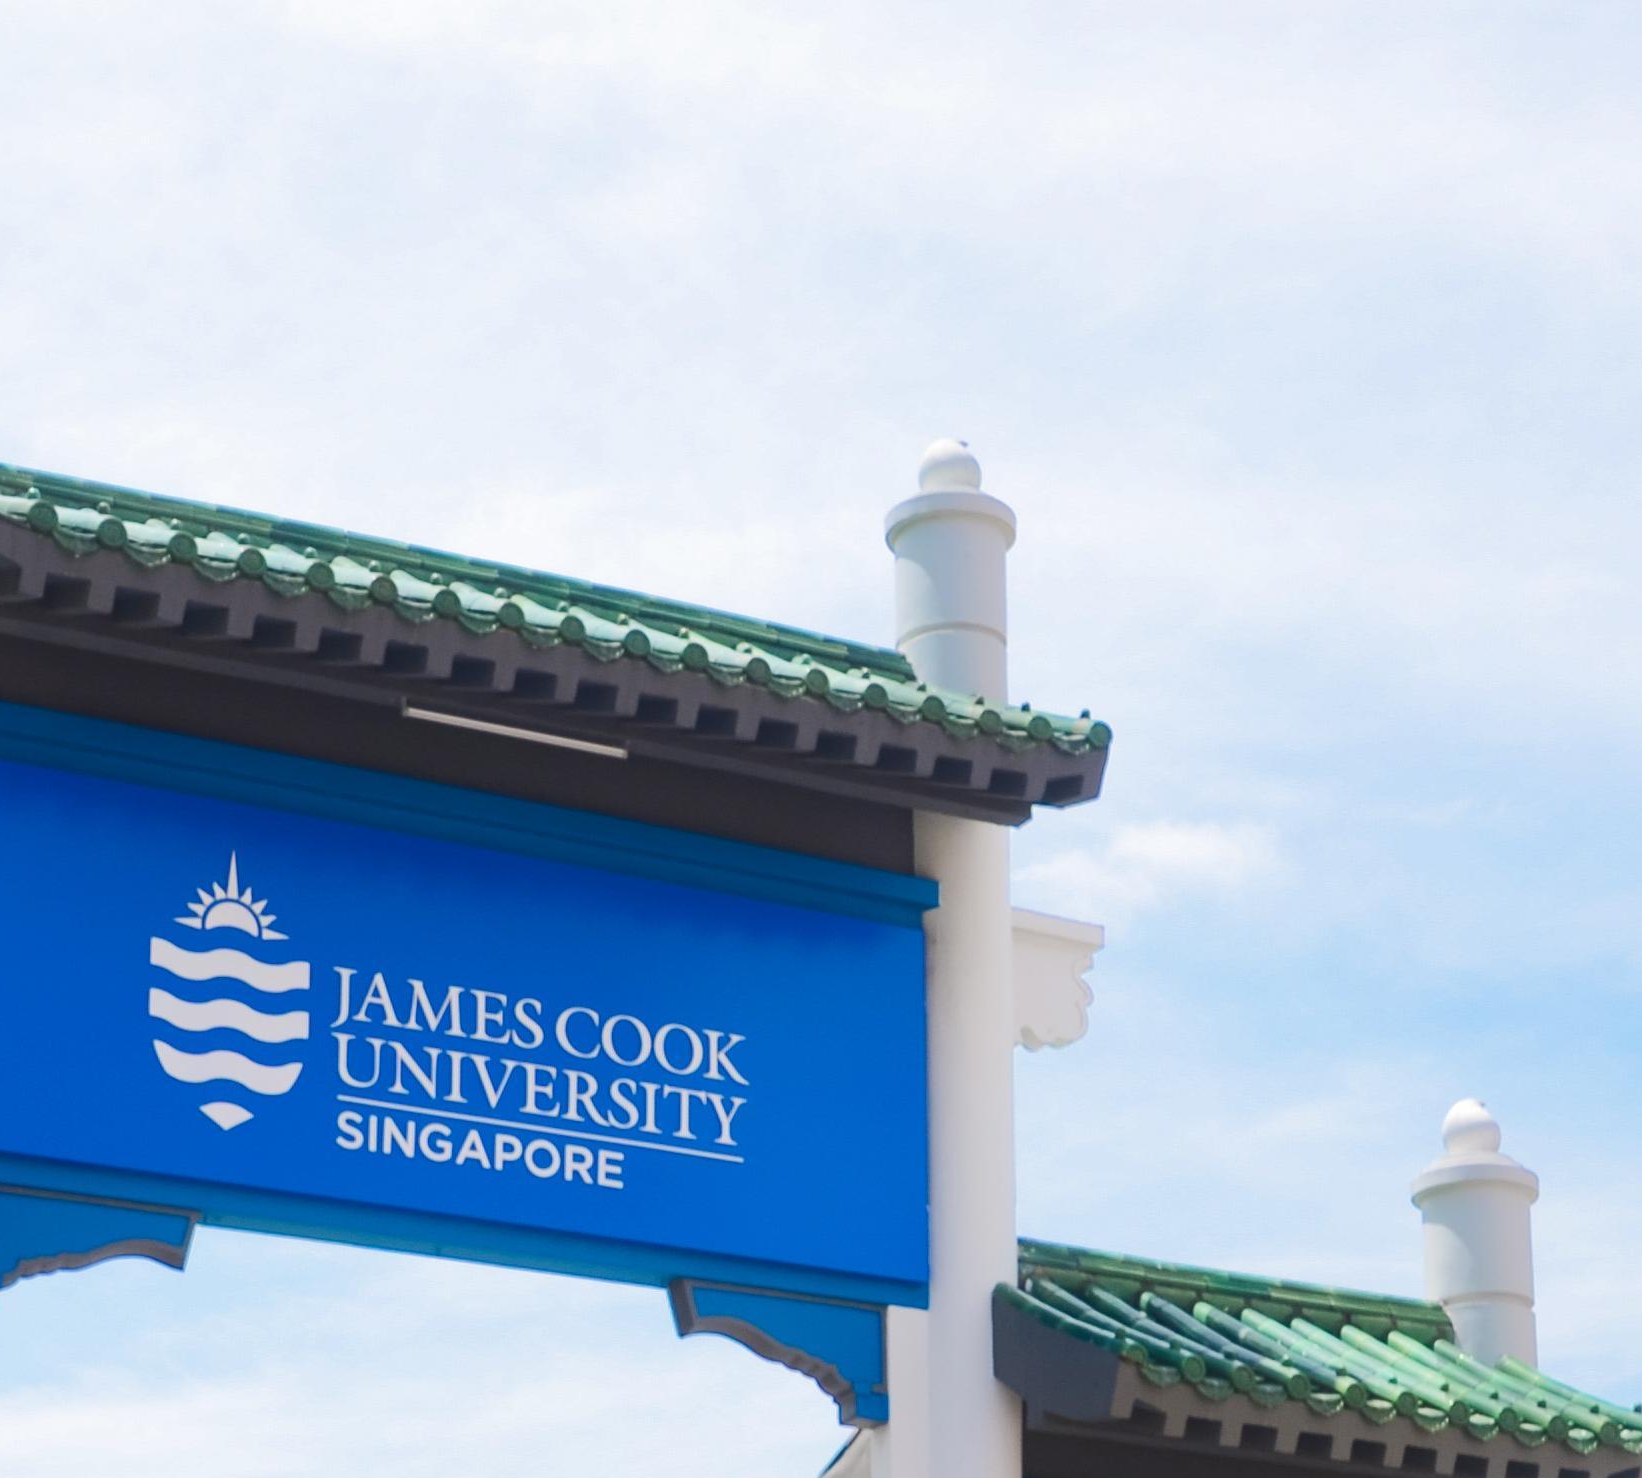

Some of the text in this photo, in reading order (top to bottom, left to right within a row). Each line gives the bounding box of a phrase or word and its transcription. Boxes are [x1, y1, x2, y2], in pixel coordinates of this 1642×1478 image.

[331, 966, 749, 1086] JAMES COOK
[331, 1032, 748, 1147] UNIVERSITY
[335, 1110, 625, 1190] SINGAPORE
